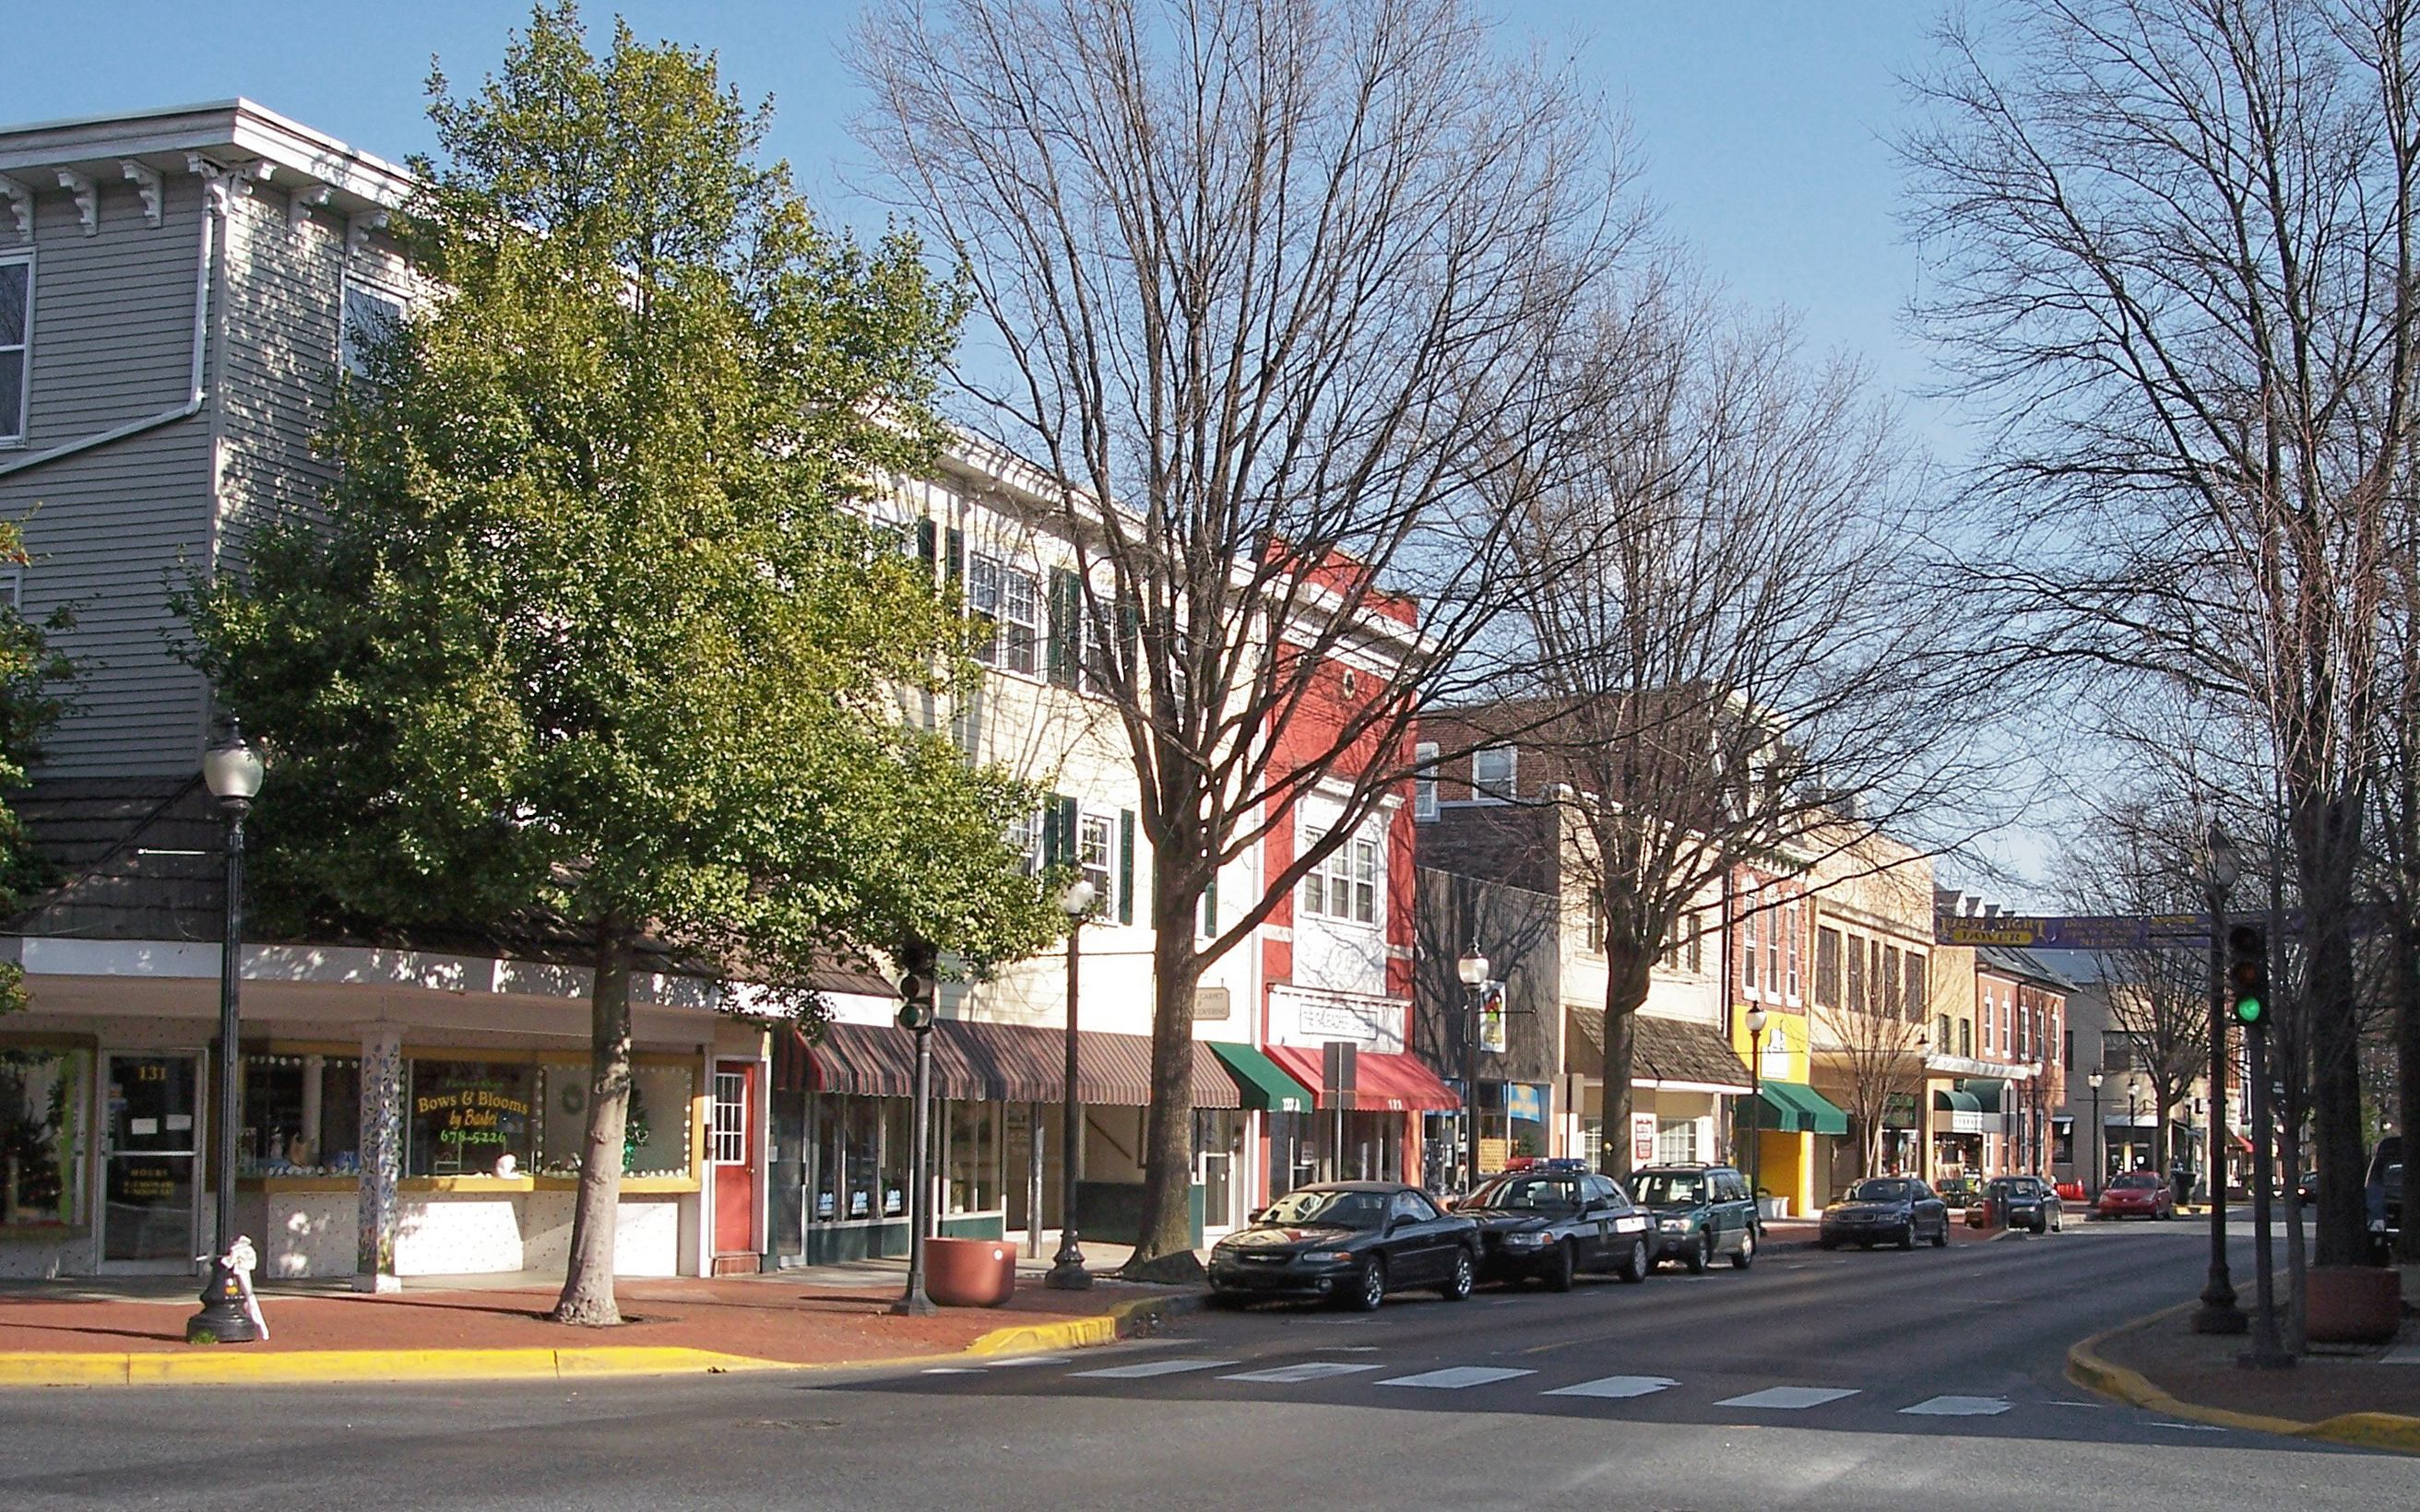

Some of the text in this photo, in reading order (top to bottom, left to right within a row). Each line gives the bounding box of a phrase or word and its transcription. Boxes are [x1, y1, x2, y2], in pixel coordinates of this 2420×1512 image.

[138, 1066, 167, 1081] 131
[418, 1091, 529, 1116] Bows & Blooms
[449, 1109, 462, 1130] by
[440, 1129, 507, 1144] 678-5226
